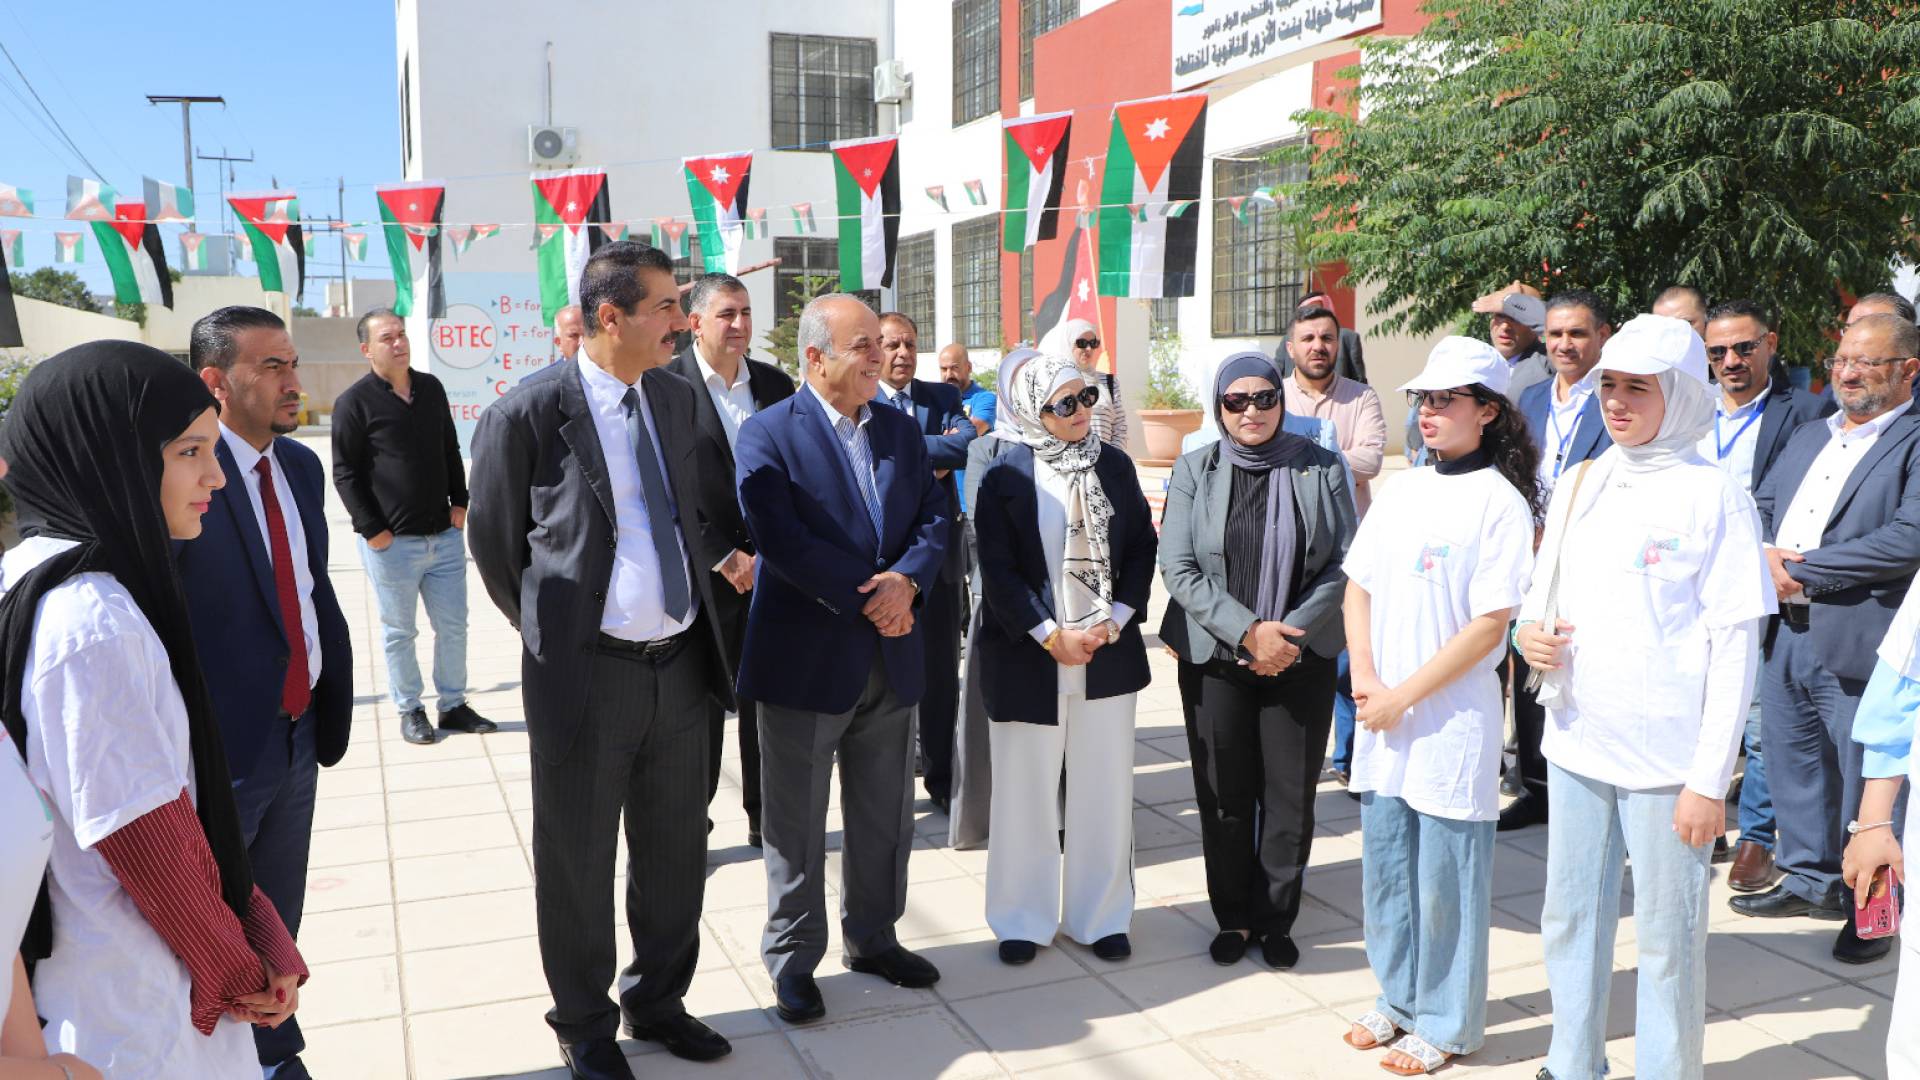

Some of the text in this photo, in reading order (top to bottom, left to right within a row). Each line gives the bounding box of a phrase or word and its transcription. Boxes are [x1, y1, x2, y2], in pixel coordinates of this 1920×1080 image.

[1305, 0, 1333, 33] خولة
[1278, 16, 1302, 41] بنت
[1211, 30, 1249, 68] الثانوية
[500, 295, 512, 314] B
[524, 299, 541, 311] for
[439, 325, 493, 348] BTEC
[508, 324, 520, 342] T
[531, 326, 550, 338] for
[503, 353, 513, 370] E
[524, 354, 544, 366] for
[448, 404, 481, 421] TEC
